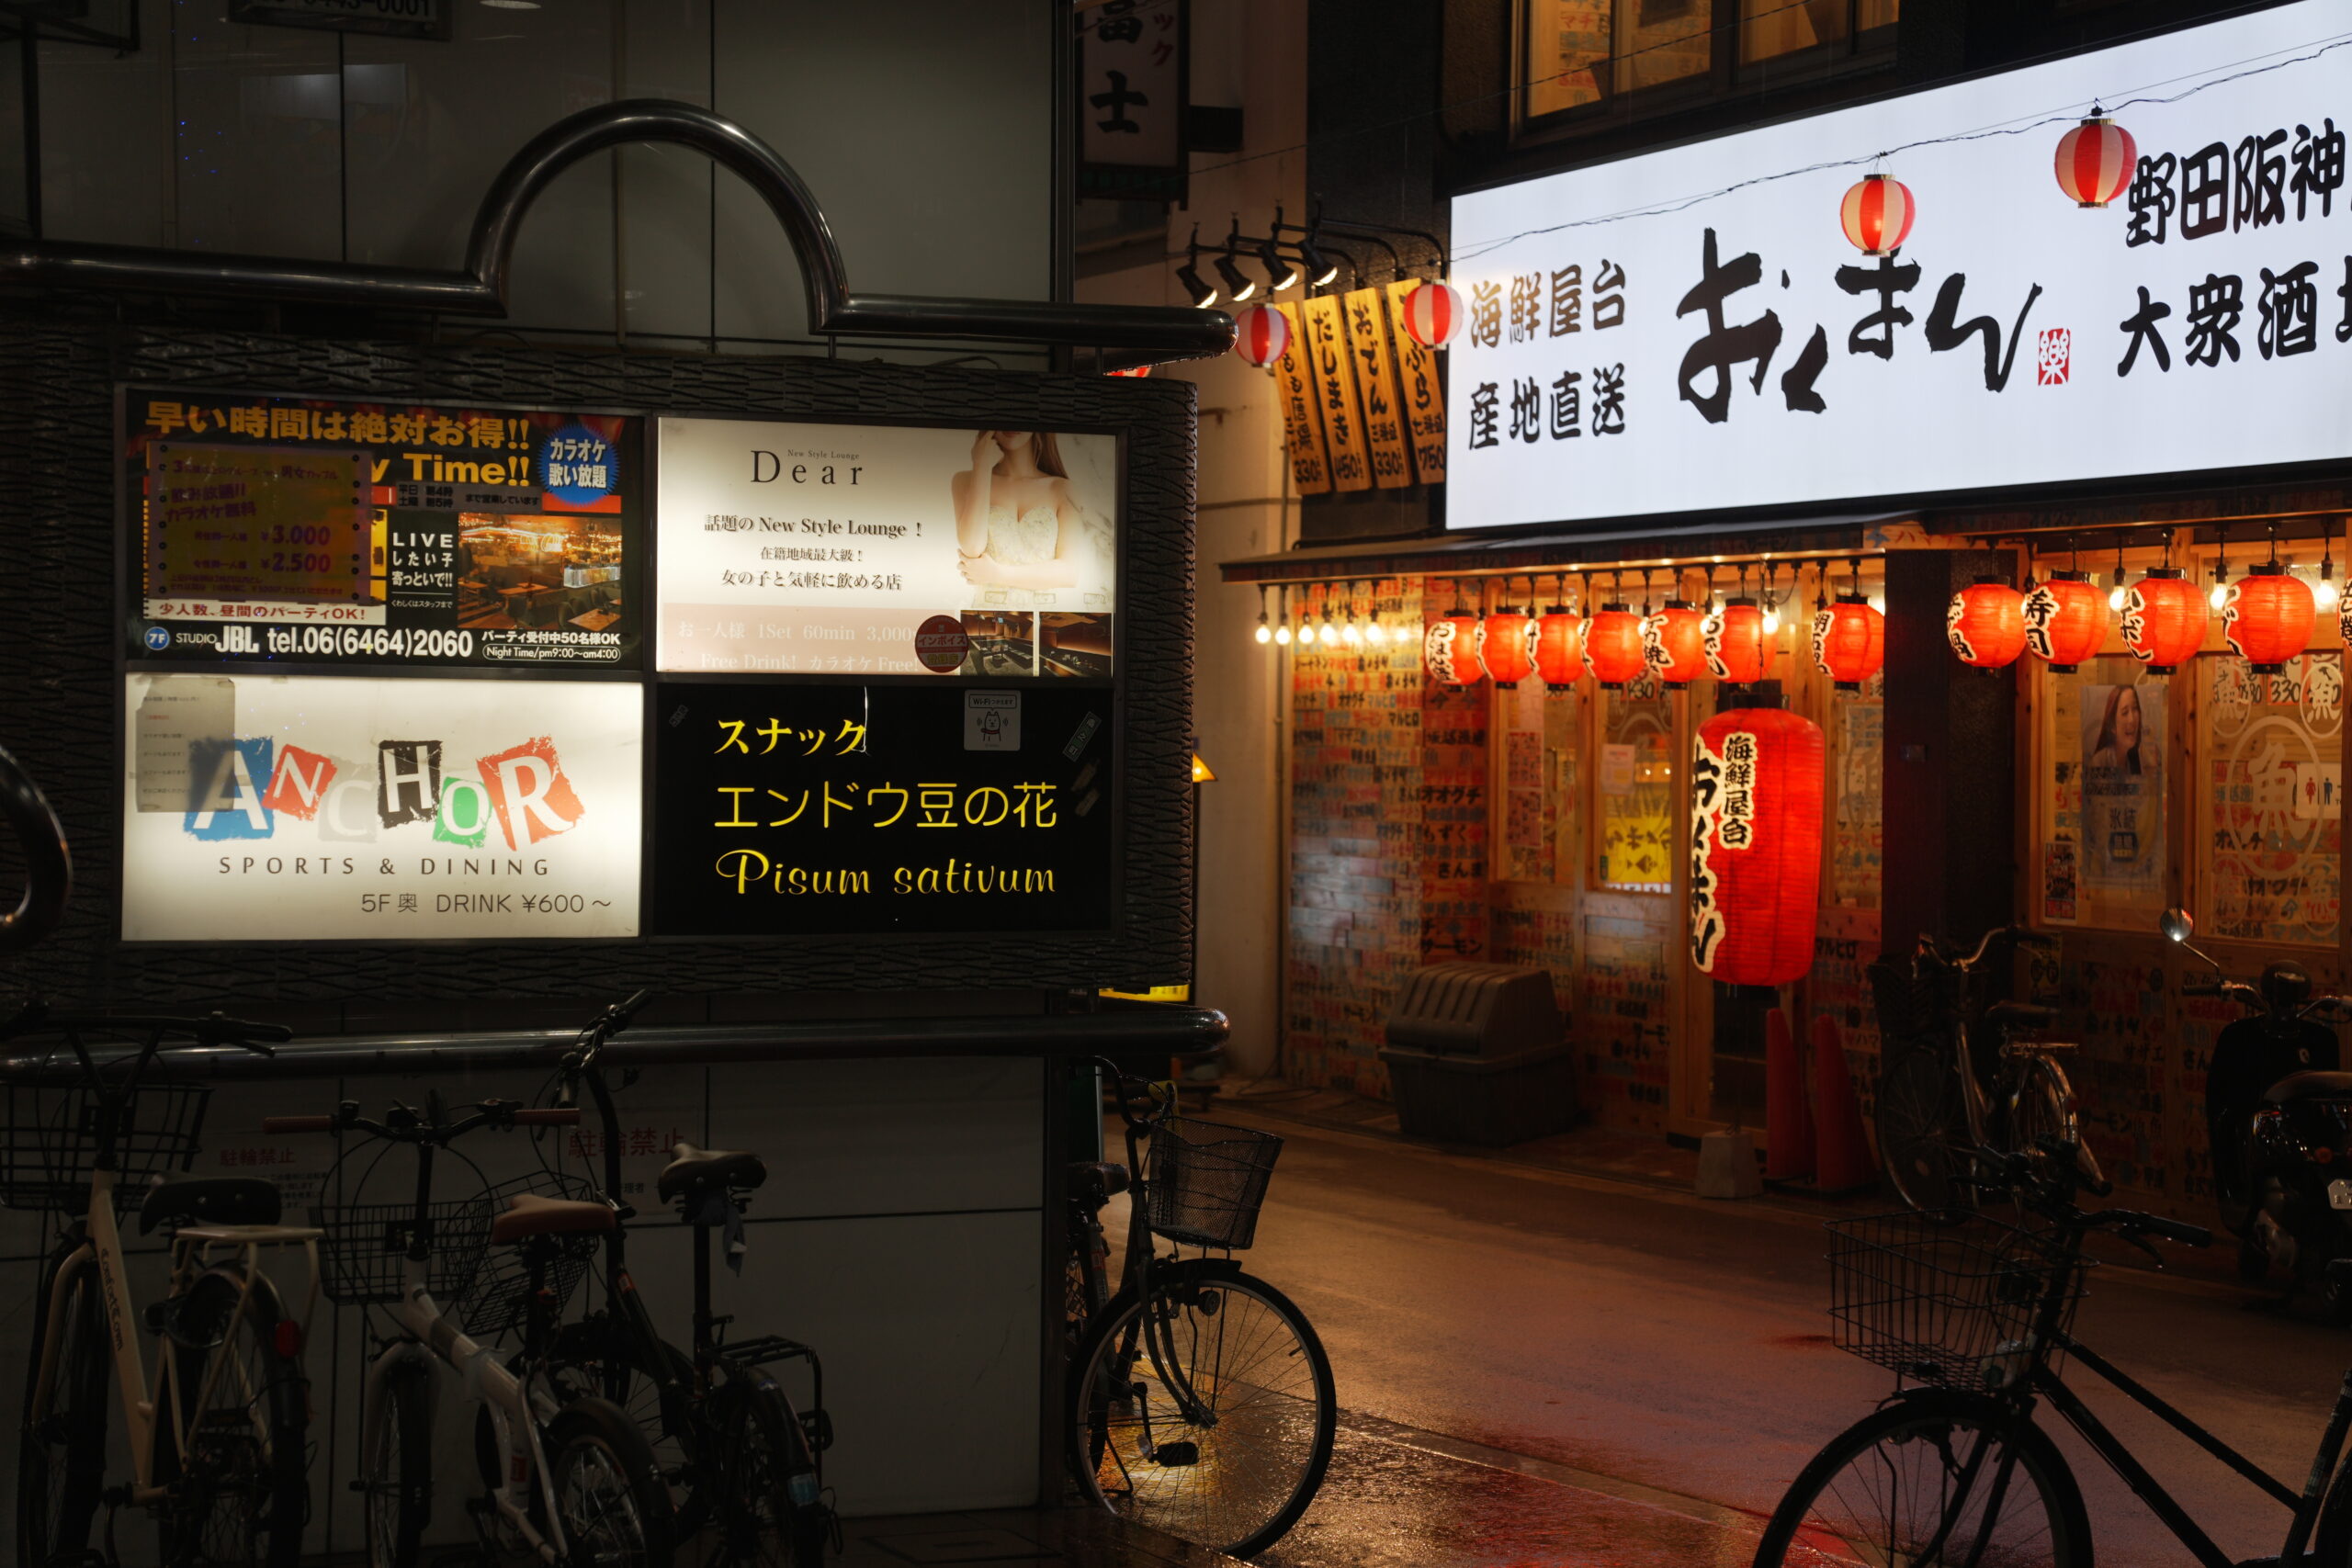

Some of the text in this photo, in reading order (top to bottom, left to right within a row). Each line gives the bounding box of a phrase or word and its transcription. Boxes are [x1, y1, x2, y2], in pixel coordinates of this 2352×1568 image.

[2126, 118, 2352, 248] 野田阪神
[1471, 259, 1625, 348] 海鮮屋台
[1677, 226, 2043, 424] おくまん
[1352, 301, 1388, 416] おでん
[1469, 362, 1625, 451] 産地直送
[145, 400, 530, 451] 早い時間は絶対お得!!
[549, 437, 606, 463] カラオケ
[787, 448, 860, 461] New Style Lounge
[402, 453, 530, 487] Time!!
[548, 462, 607, 489] 歌い放題
[750, 449, 863, 486] Dear
[392, 532, 454, 548] LIVE
[704, 513, 753, 534] 話題の
[758, 516, 795, 535] New
[800, 517, 842, 537] Style
[847, 520, 907, 540] Lounge
[392, 552, 454, 567] したい子
[391, 571, 453, 588] 寄っといで!!
[720, 570, 903, 592] 女の子と気軽に飲める店
[160, 603, 366, 621] 少人数、昼間のパーティOK!
[2025, 590, 2056, 658] 寿司
[148, 634, 165, 644] 7F
[175, 625, 474, 659] STUDIO JBL tel.06(6464)2060
[481, 630, 621, 646] パーティ受付中50名様OK
[678, 620, 918, 643] お一人様 1Set 60min 3,000
[919, 635, 966, 647] インボイス
[486, 646, 512, 660] Night
[700, 653, 741, 671] Free
[743, 653, 797, 671] Drink!
[808, 655, 872, 673] カラオケ
[876, 655, 919, 673] Free!
[714, 717, 867, 757] スナック
[189, 740, 579, 851] ANCHOR
[1723, 735, 1755, 845] 海鮮屋台
[714, 780, 1057, 829] エンドウ豆の花
[219, 856, 549, 875] SPORTS & DINING
[715, 848, 1057, 896] Pisum sativum
[435, 893, 513, 913] DRINK
[220, 1146, 295, 1167] 駐輪禁止
